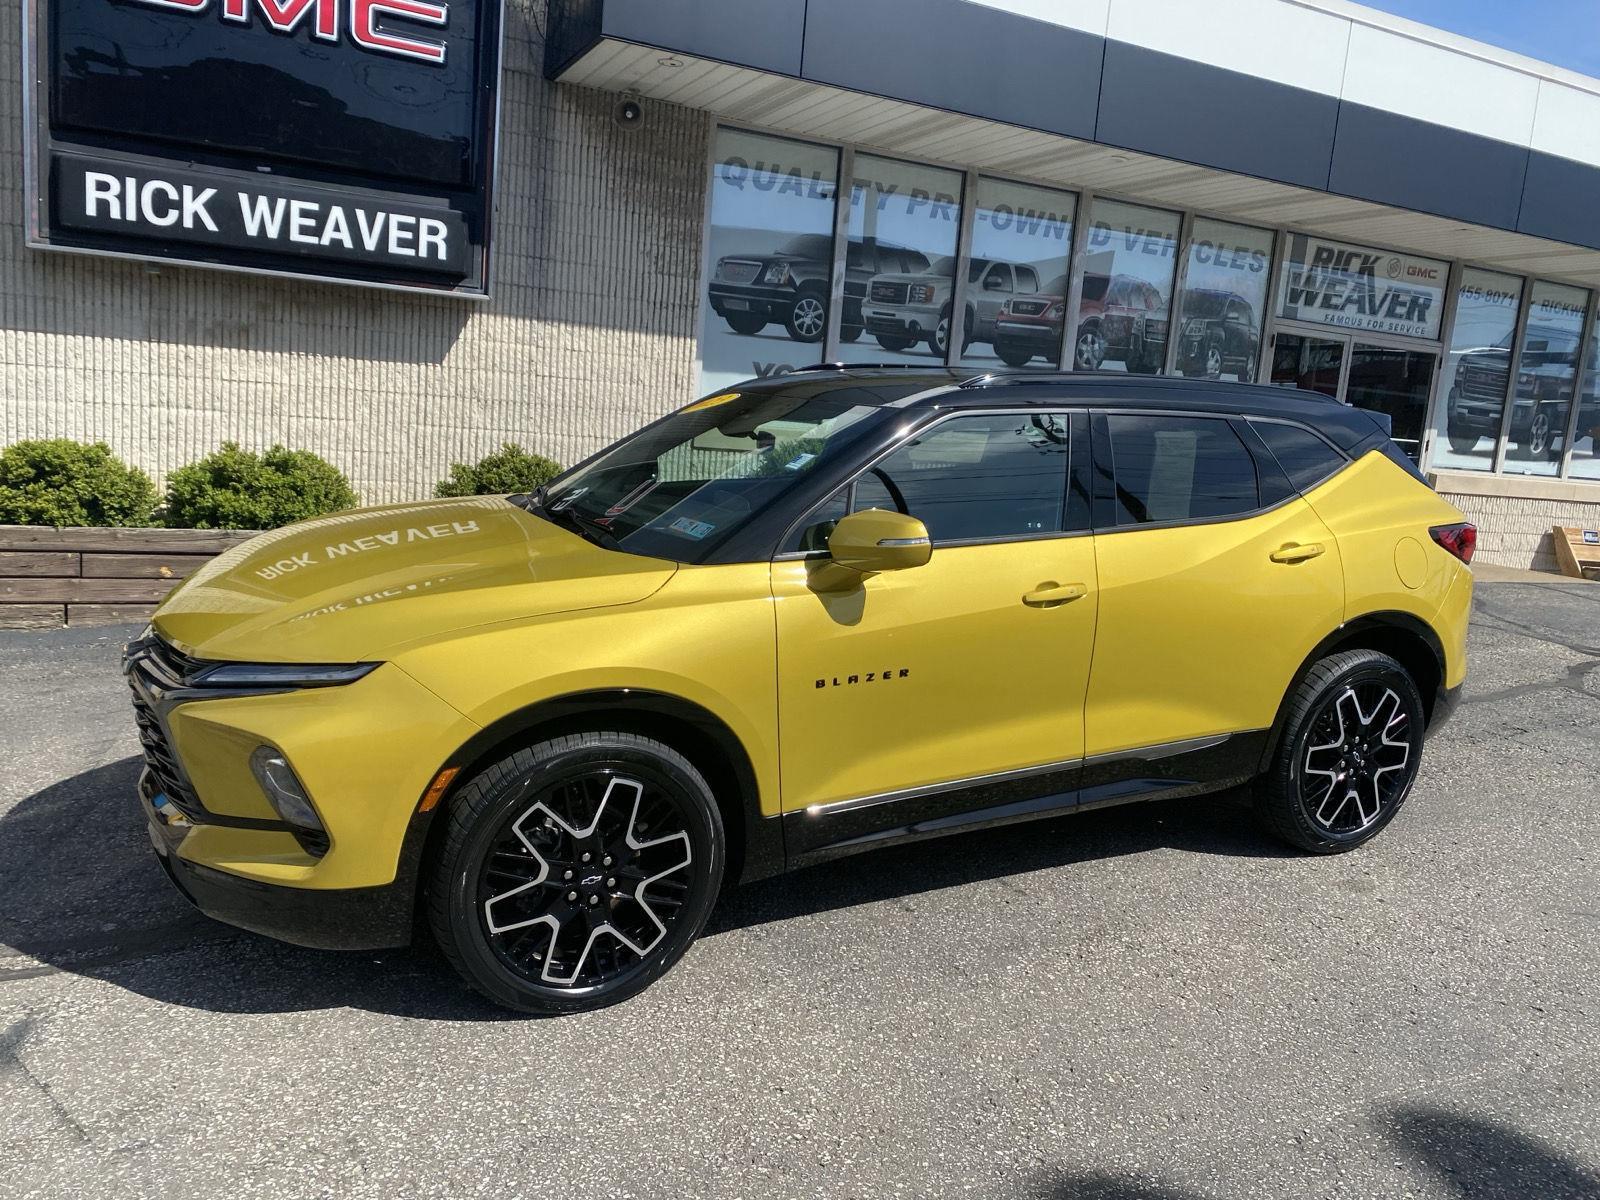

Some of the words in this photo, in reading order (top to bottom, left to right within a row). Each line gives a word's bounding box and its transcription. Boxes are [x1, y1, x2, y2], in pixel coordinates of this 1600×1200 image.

[128, 0, 447, 63] MC
[83, 171, 220, 232] RICK
[238, 192, 448, 260] WEAVER
[720, 156, 898, 211] QUALTY
[906, 187, 1112, 246] PR-OWND
[1125, 226, 1266, 273] VEHCLES
[1307, 246, 1384, 282] RICK
[1406, 266, 1438, 280] GMC
[1287, 272, 1434, 324] WEAVER
[1324, 313, 1363, 327] FAMOUS
[1366, 319, 1384, 331] FOR
[1388, 323, 1426, 335] SERVICE
[815, 668, 910, 689] BLAZER
